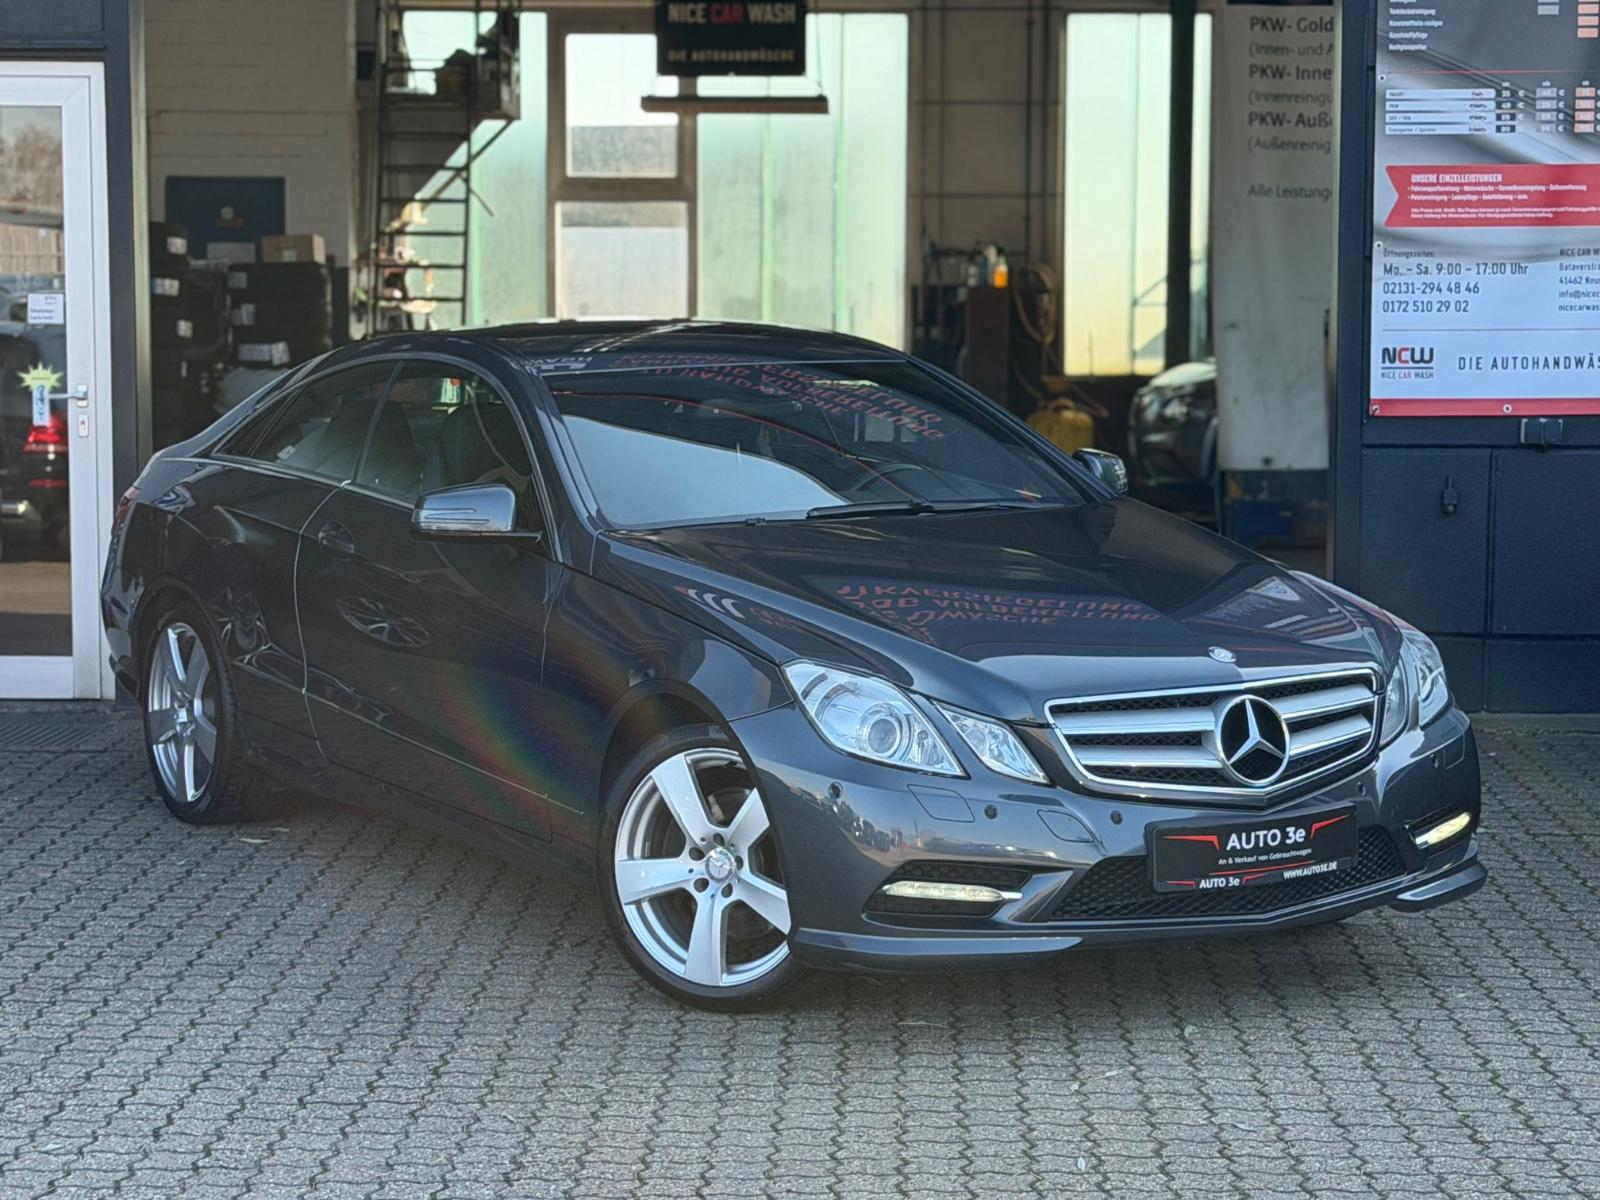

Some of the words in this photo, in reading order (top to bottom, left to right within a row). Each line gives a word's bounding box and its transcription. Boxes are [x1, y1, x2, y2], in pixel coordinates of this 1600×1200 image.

[668, 3, 706, 24] NICE
[710, 3, 743, 24] CAR
[747, 3, 797, 24] WASH
[1249, 16, 1292, 33] PKW-
[1296, 16, 1333, 33] Gold
[1297, 42, 1323, 56] und
[1249, 64, 1292, 80] PKW-
[1295, 66, 1332, 80] Inne
[1248, 111, 1292, 128] PKW-
[1560, 248, 1575, 256] NICE
[1577, 248, 1591, 256] CAR
[1383, 262, 1403, 276] Mo.
[1416, 262, 1432, 276] Sa.
[1436, 262, 1462, 275] 9:00
[1475, 262, 1507, 275] 17:00
[1510, 262, 1528, 275] Uhr
[1559, 276, 1583, 285] 41462
[1383, 281, 1443, 295] 02131-294
[1446, 281, 1461, 295] 48
[1465, 281, 1480, 294] 46
[1382, 300, 1409, 313] 0172
[1412, 300, 1433, 313] 510
[1436, 300, 1451, 313] 29
[1454, 300, 1469, 313] 02
[1381, 347, 1434, 365] NCW
[1458, 356, 1483, 371] DIE
[1381, 371, 1396, 380] NICE
[1399, 371, 1412, 380] CAR
[1414, 371, 1434, 380] WASH
[1226, 828, 1281, 851] AUTO
[1285, 826, 1306, 844] 3e
[1234, 855, 1257, 864] Verkauf
[1199, 878, 1227, 889] AUTO
[1228, 876, 1240, 887] 3e
